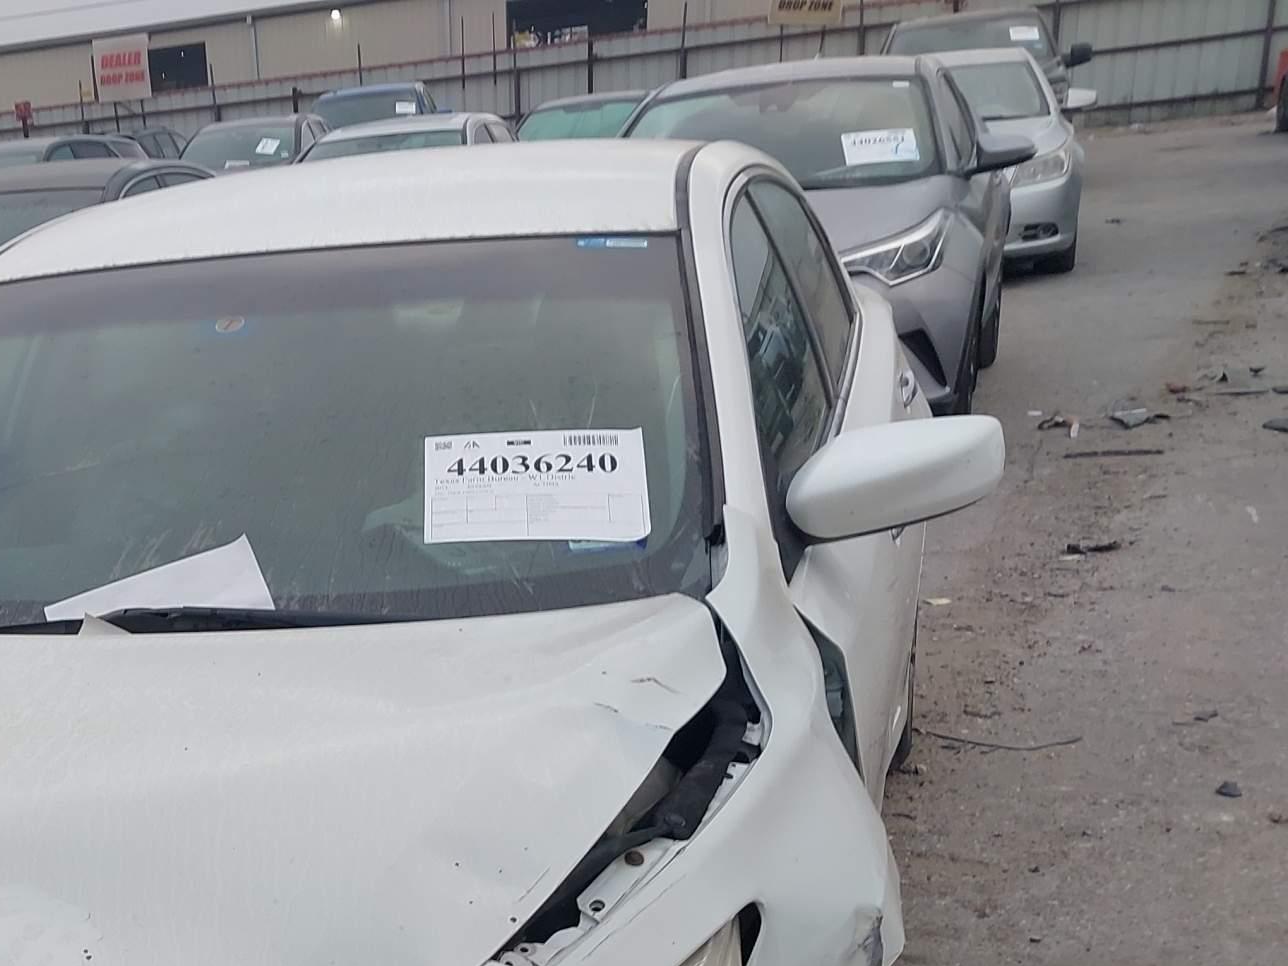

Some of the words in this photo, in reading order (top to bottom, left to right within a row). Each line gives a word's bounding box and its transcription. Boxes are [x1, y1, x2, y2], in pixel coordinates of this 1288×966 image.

[101, 51, 142, 69] DEALER
[100, 74, 123, 86] DROP
[124, 70, 145, 84] ZONE
[446, 453, 618, 476] 44036240
